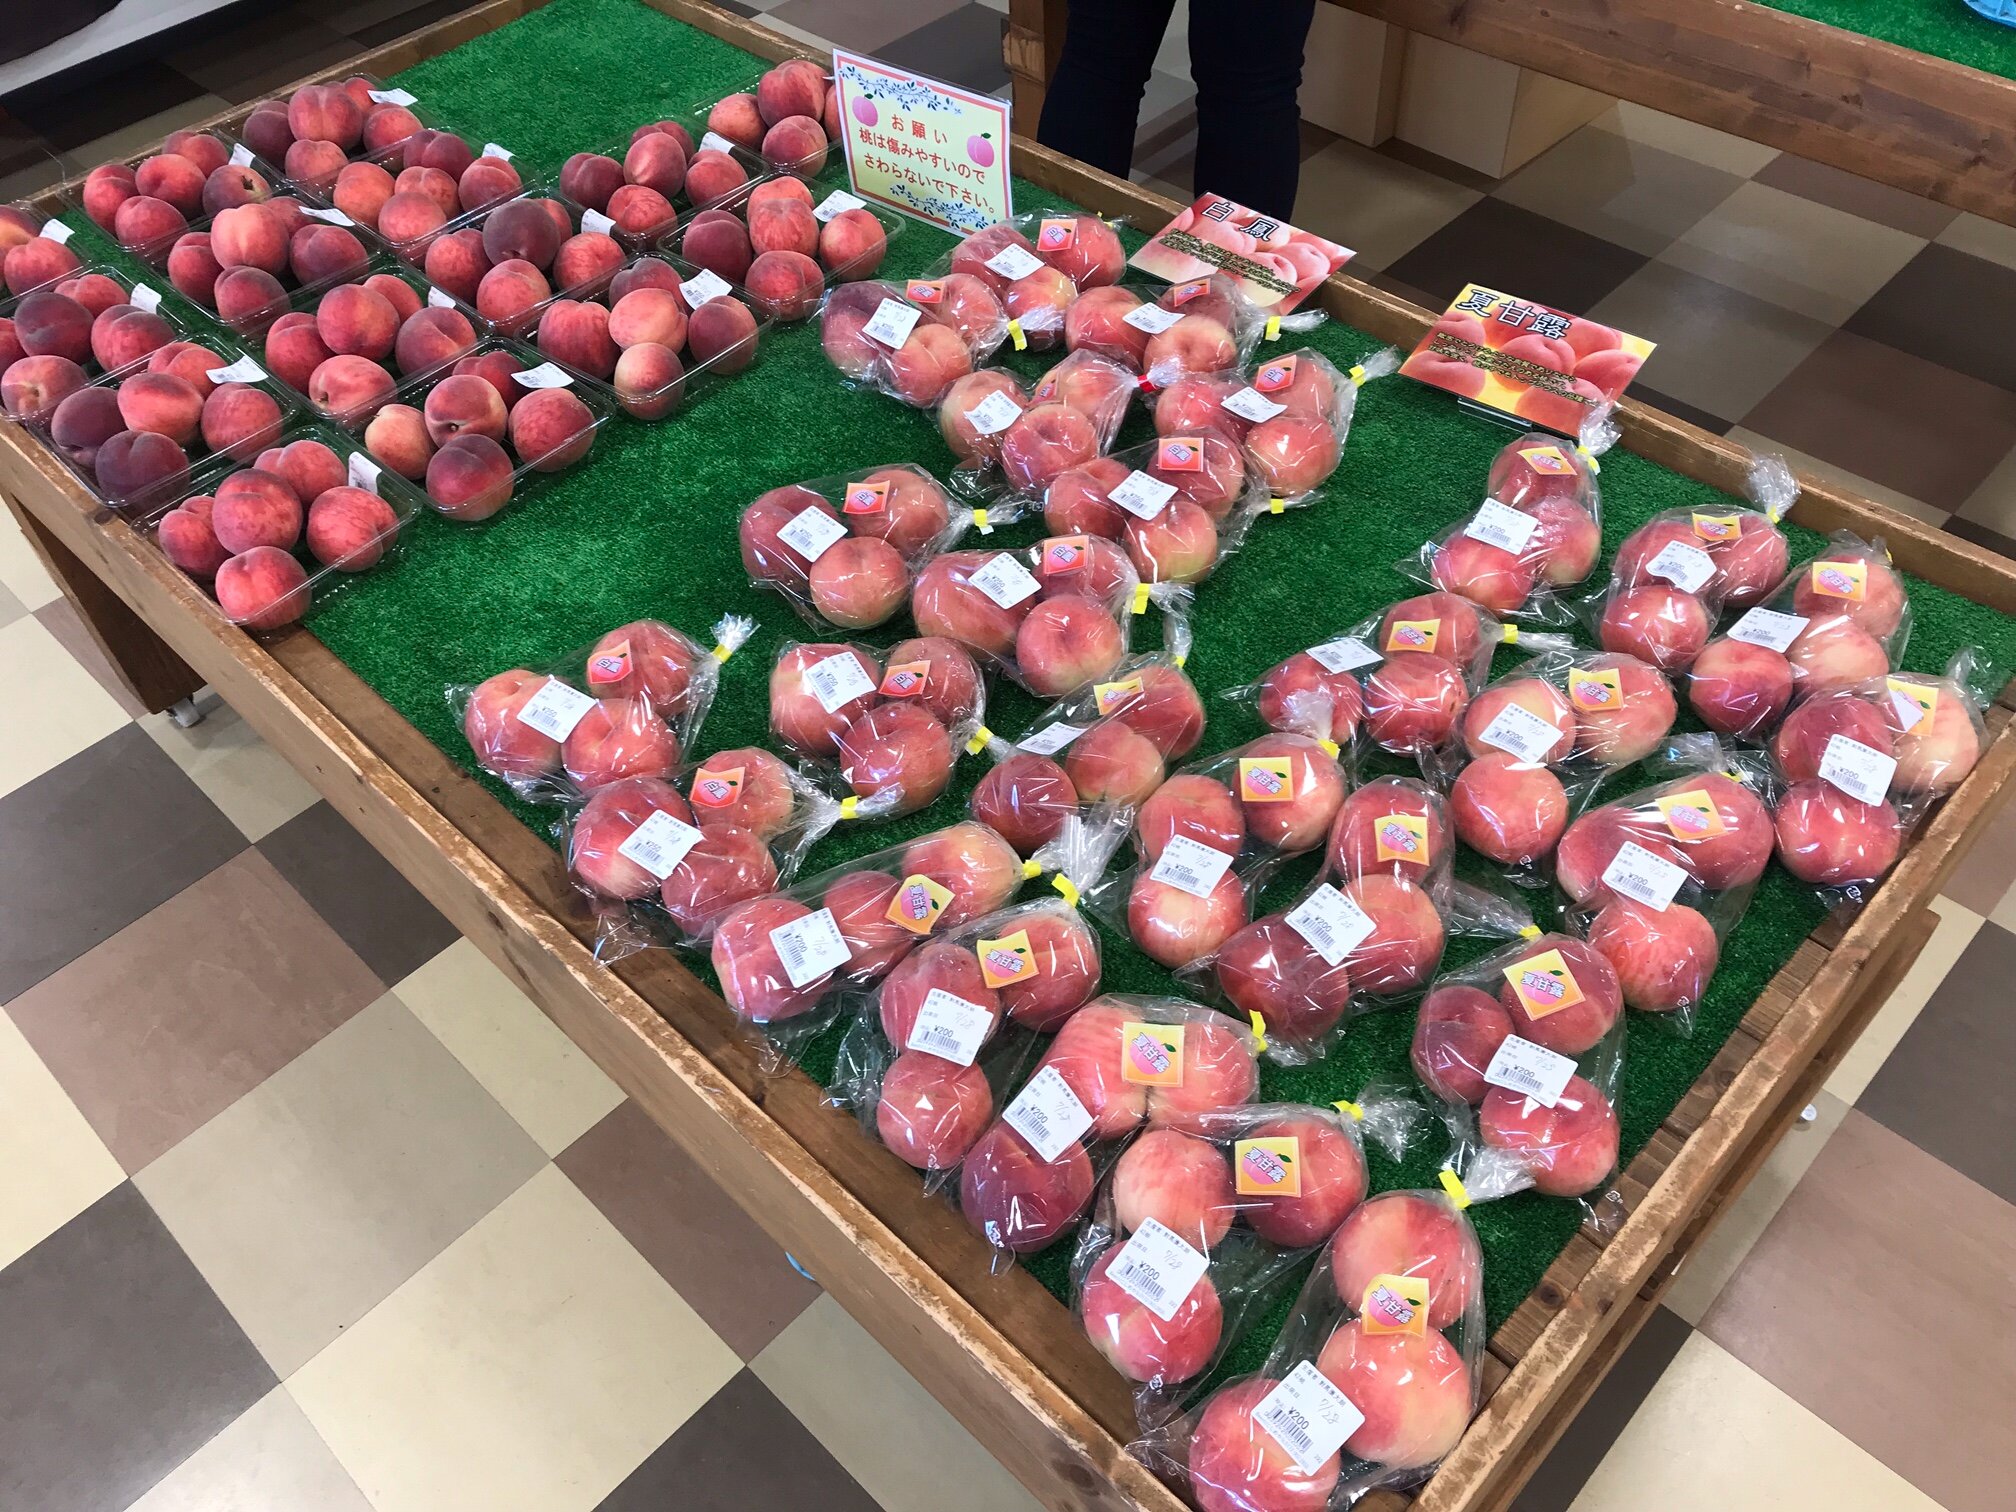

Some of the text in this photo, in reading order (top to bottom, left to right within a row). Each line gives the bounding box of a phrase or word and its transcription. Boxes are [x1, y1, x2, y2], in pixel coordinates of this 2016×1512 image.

[892, 114, 947, 144] お願い
[859, 127, 985, 185] 桃は傷みやすいので
[864, 153, 994, 214] さわらないで下さい。
[1202, 202, 1279, 241] 白鳳
[1455, 288, 1572, 340] 夏甘露
[1506, 729, 1524, 741] ¥200
[1839, 767, 1859, 779] ¥200
[1175, 863, 1193, 875] ¥200
[1628, 872, 1648, 886] ¥200
[1314, 915, 1333, 932] ¥200
[934, 1025, 954, 1038] ¥200
[1514, 1065, 1535, 1078] ¥200
[1030, 1104, 1049, 1124] ¥200
[1139, 1260, 1160, 1280] ¥200
[1288, 1406, 1309, 1429] ¥200
